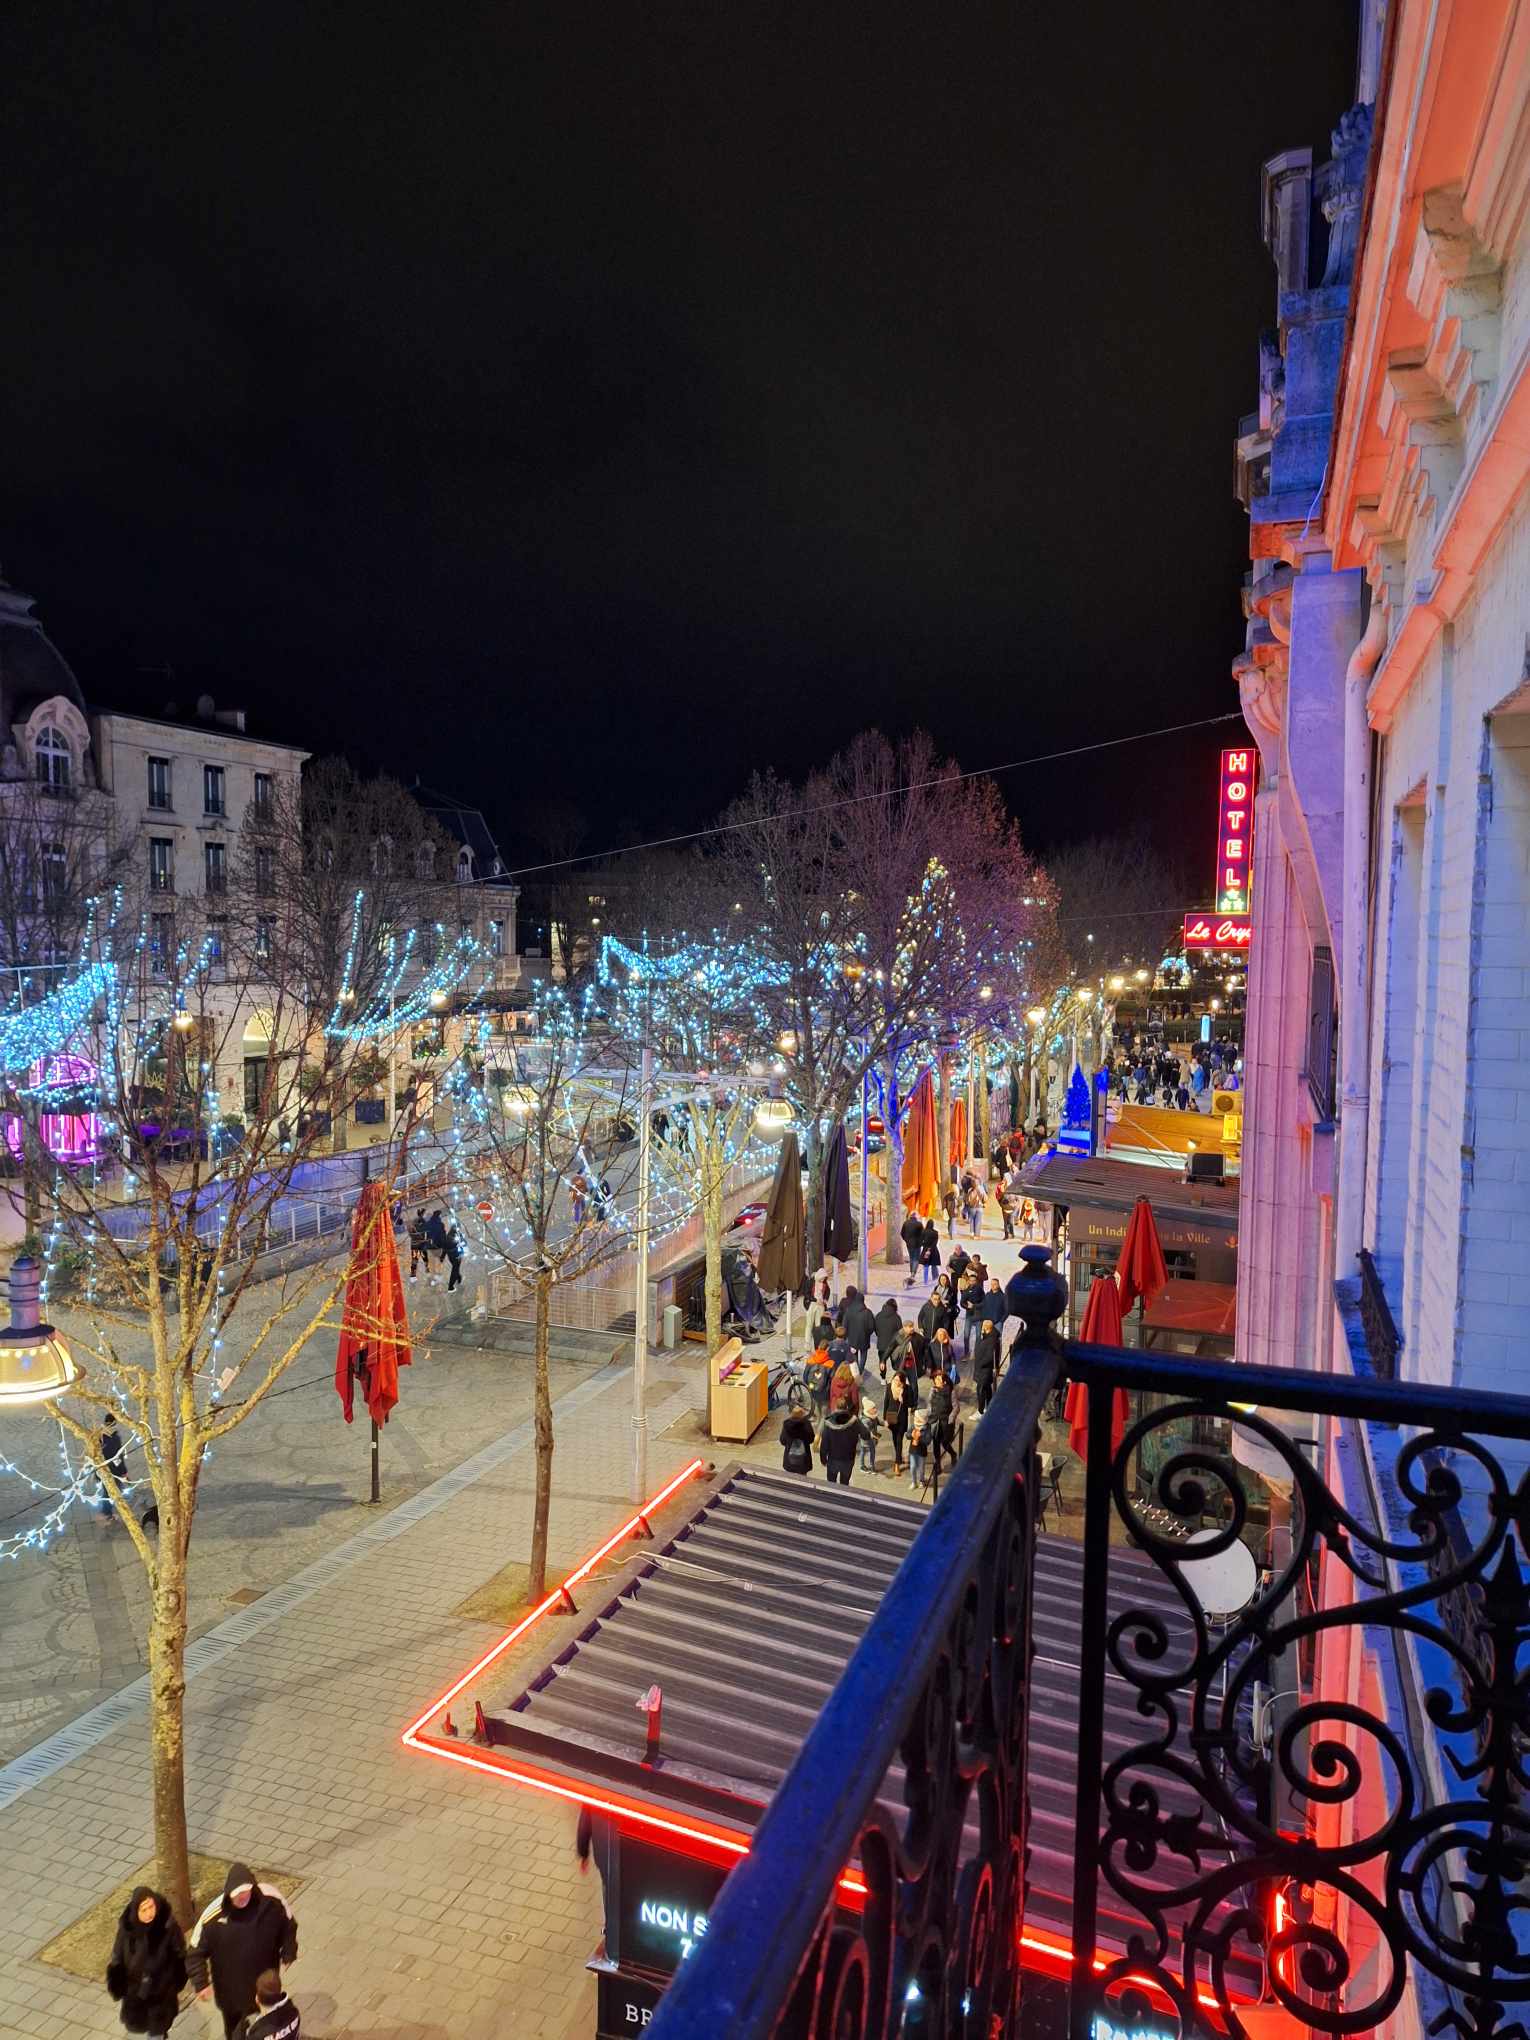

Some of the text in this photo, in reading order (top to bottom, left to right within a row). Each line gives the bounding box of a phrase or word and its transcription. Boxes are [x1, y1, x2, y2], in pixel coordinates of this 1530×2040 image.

[1226, 753, 1247, 887] HOTEL
[1186, 920, 1210, 938] Le
[1088, 1224, 1103, 1235] Un
[1186, 1232, 1211, 1244] Ville
[641, 1901, 688, 1933] NON
